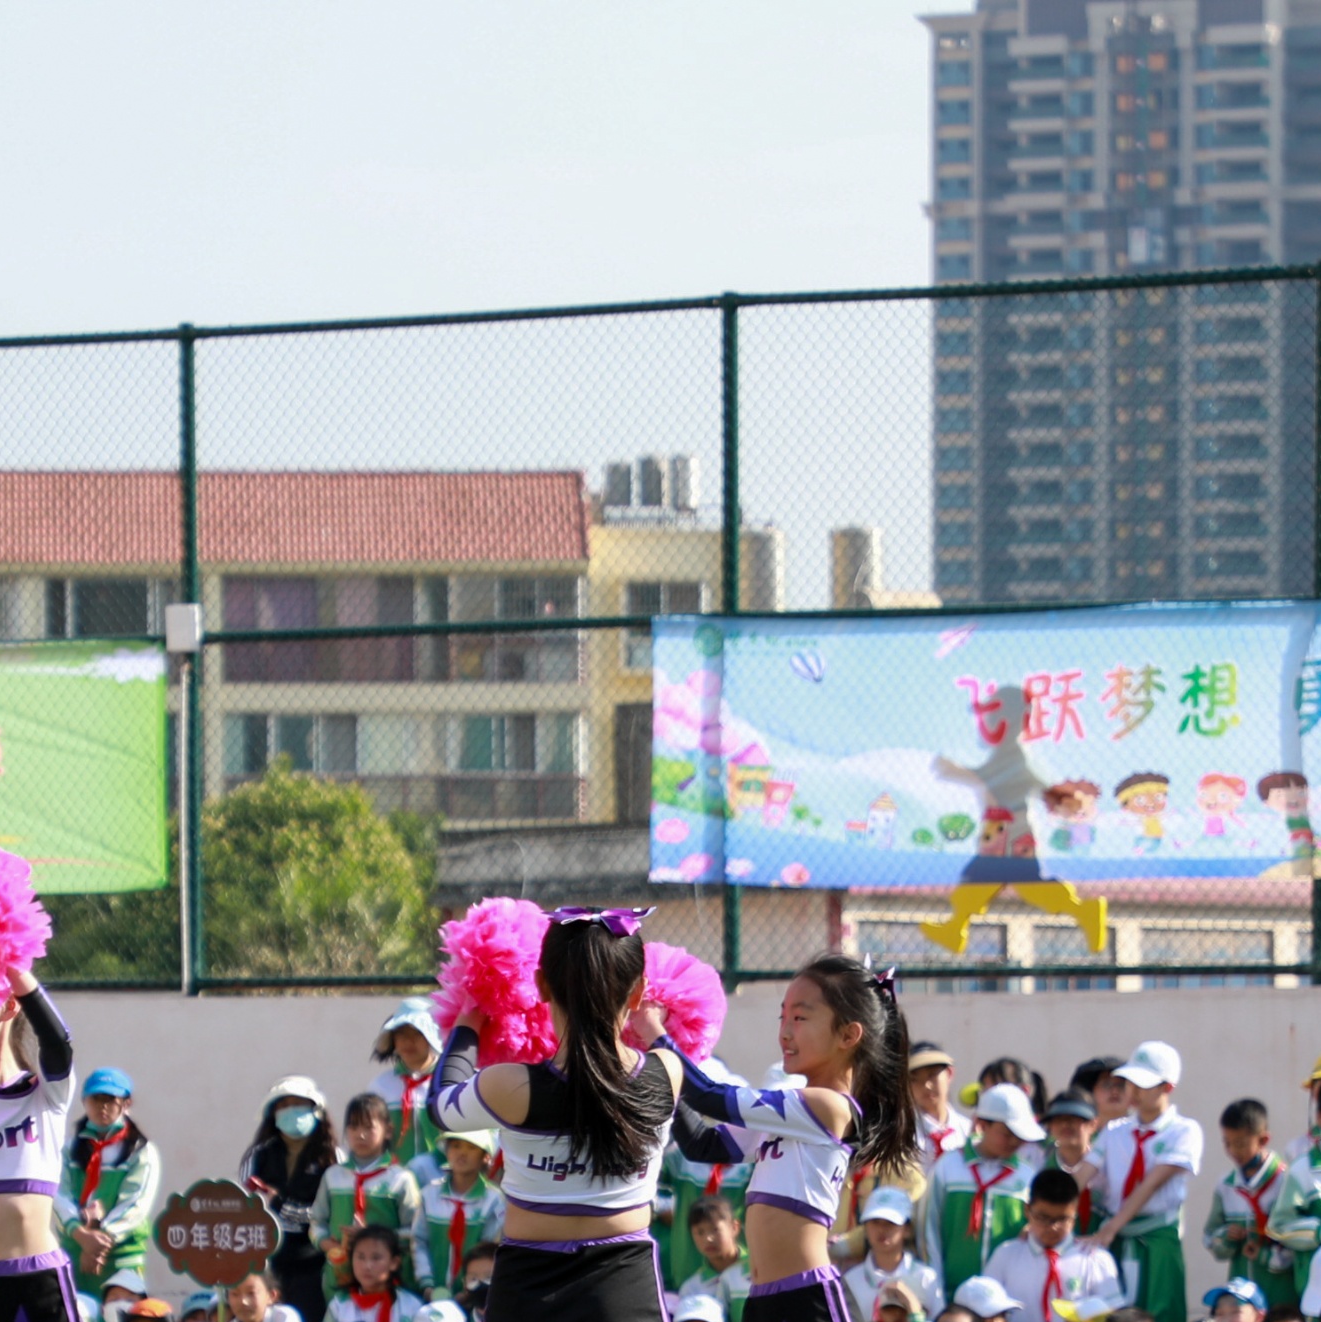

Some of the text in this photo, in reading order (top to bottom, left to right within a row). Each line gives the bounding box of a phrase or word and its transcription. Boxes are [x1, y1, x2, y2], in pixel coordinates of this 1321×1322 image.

[954, 660, 1240, 746] 飞跃梦想
[166, 1221, 268, 1254] 四年级5班
